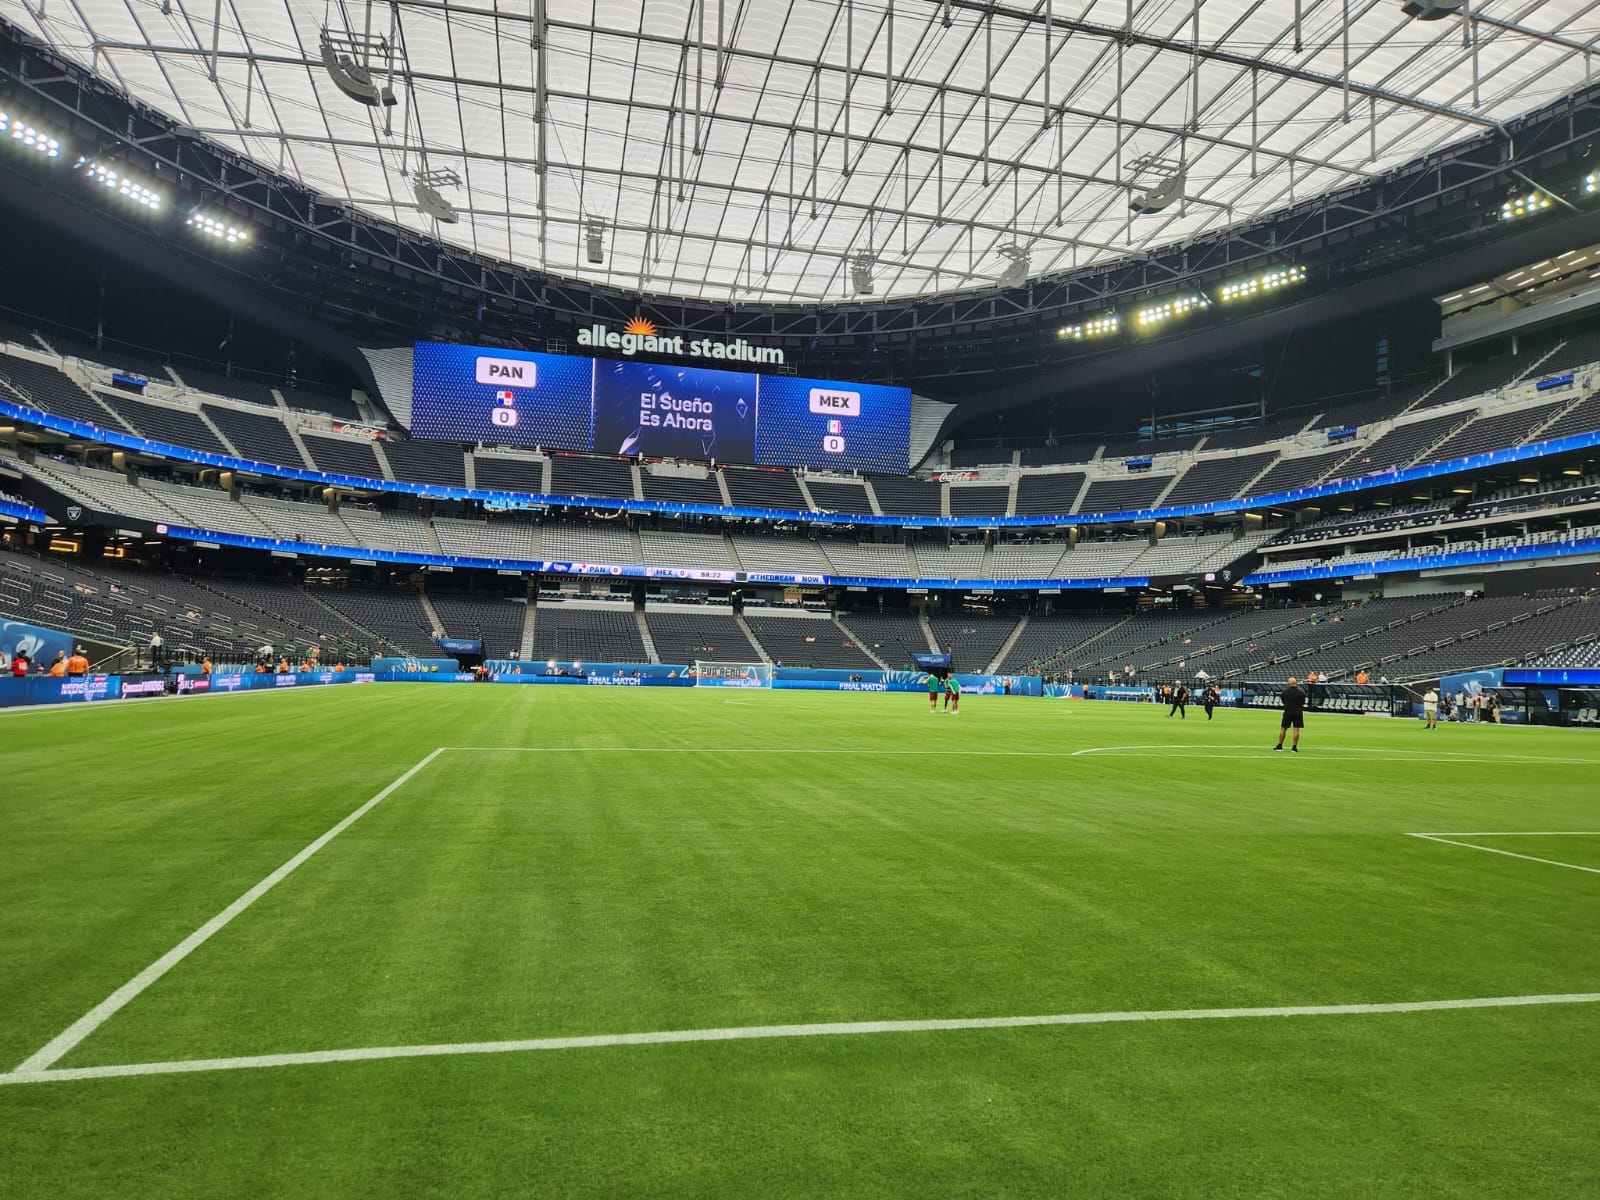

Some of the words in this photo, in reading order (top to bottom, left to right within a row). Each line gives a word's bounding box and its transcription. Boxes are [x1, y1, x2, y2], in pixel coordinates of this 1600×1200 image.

[577, 324, 683, 355] allegiant
[689, 338, 784, 364] stadium
[489, 364, 523, 379] PAN
[640, 392, 656, 409] El
[660, 392, 713, 413] Sueño
[820, 395, 850, 409] MEX
[640, 410, 660, 426] Es
[663, 412, 713, 431] Ahora
[589, 566, 606, 574] PAN
[749, 573, 796, 582] #THEDREAM
[801, 575, 820, 583] NOW
[587, 676, 611, 684] FINAL
[612, 677, 641, 686] MATCH
[838, 682, 861, 690] FINAL
[861, 683, 887, 692] MATCH
